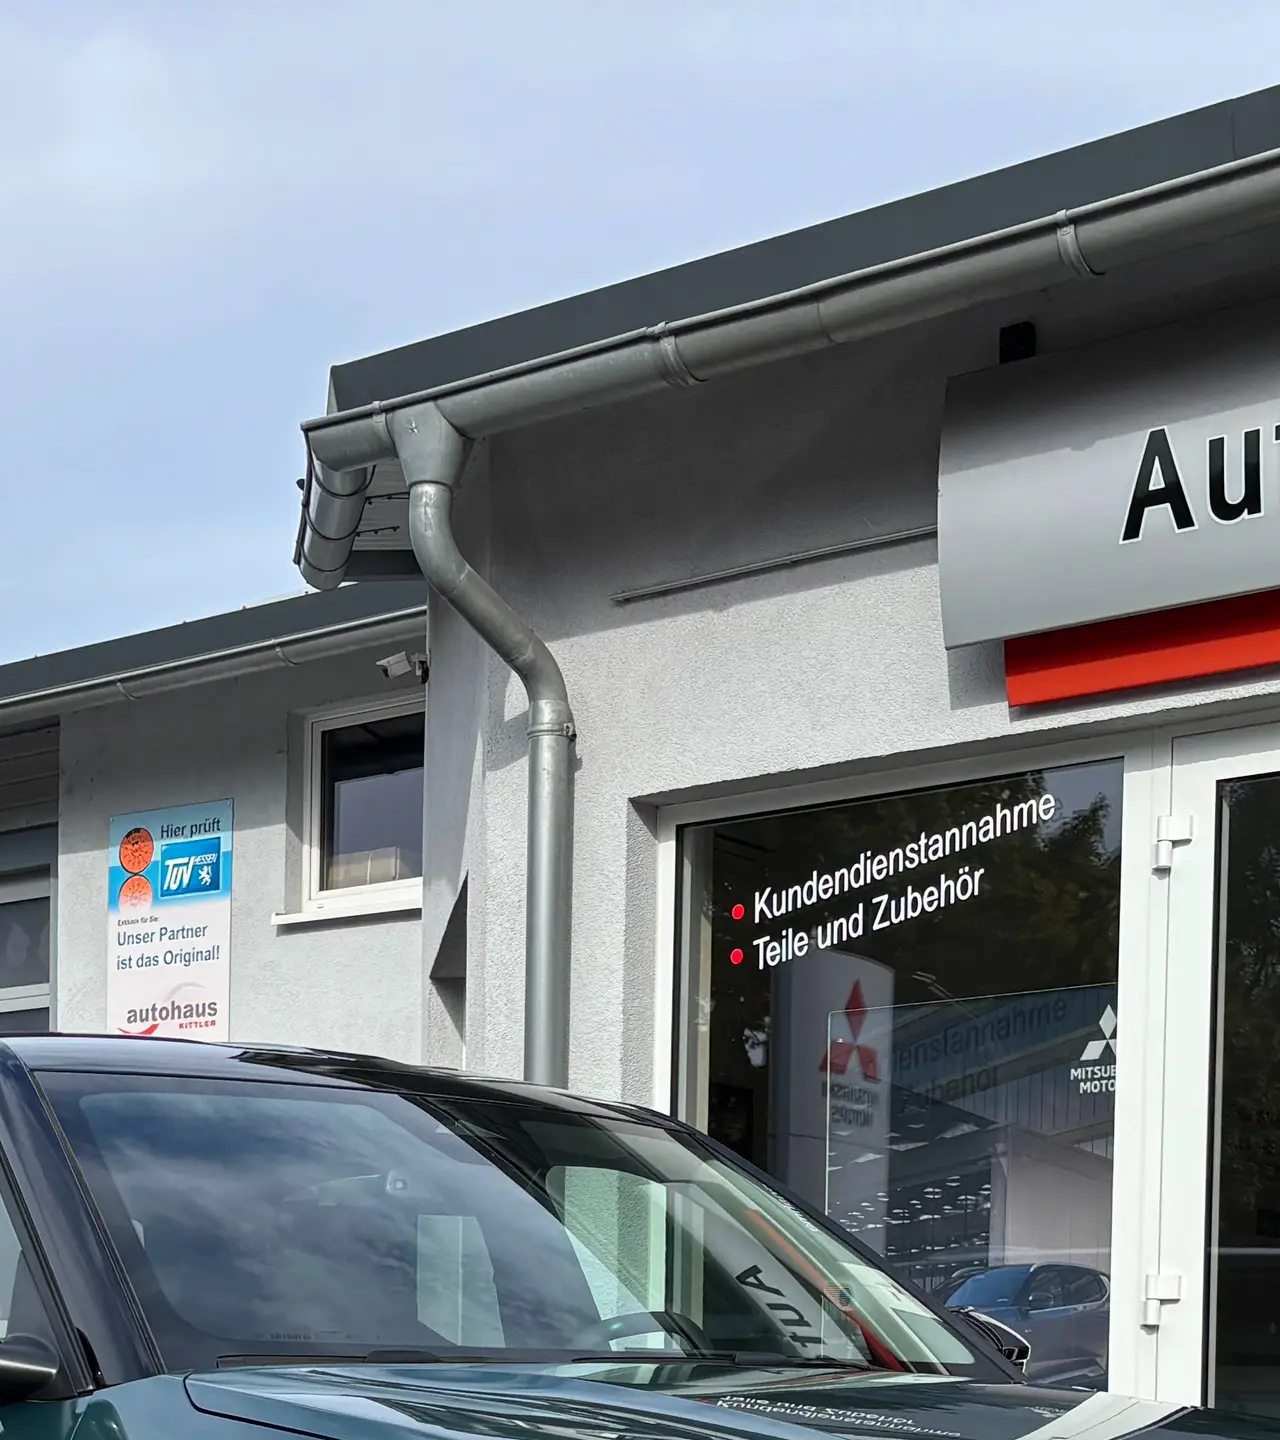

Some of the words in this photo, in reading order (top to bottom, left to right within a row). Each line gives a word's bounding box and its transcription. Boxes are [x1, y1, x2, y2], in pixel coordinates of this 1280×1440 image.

[160, 824, 187, 839] Hier
[190, 818, 221, 839] prüft
[753, 793, 1056, 924] Kundendienstannahme
[753, 929, 809, 970] Teile
[817, 902, 864, 950] und
[872, 867, 985, 931] Zubehör
[117, 931, 156, 946] Unser
[159, 925, 208, 942] Partner
[116, 955, 133, 970] ist
[136, 953, 160, 968] das
[163, 945, 220, 967] Original!
[126, 1000, 218, 1024] autohaus
[179, 1019, 217, 1030] KITTLER
